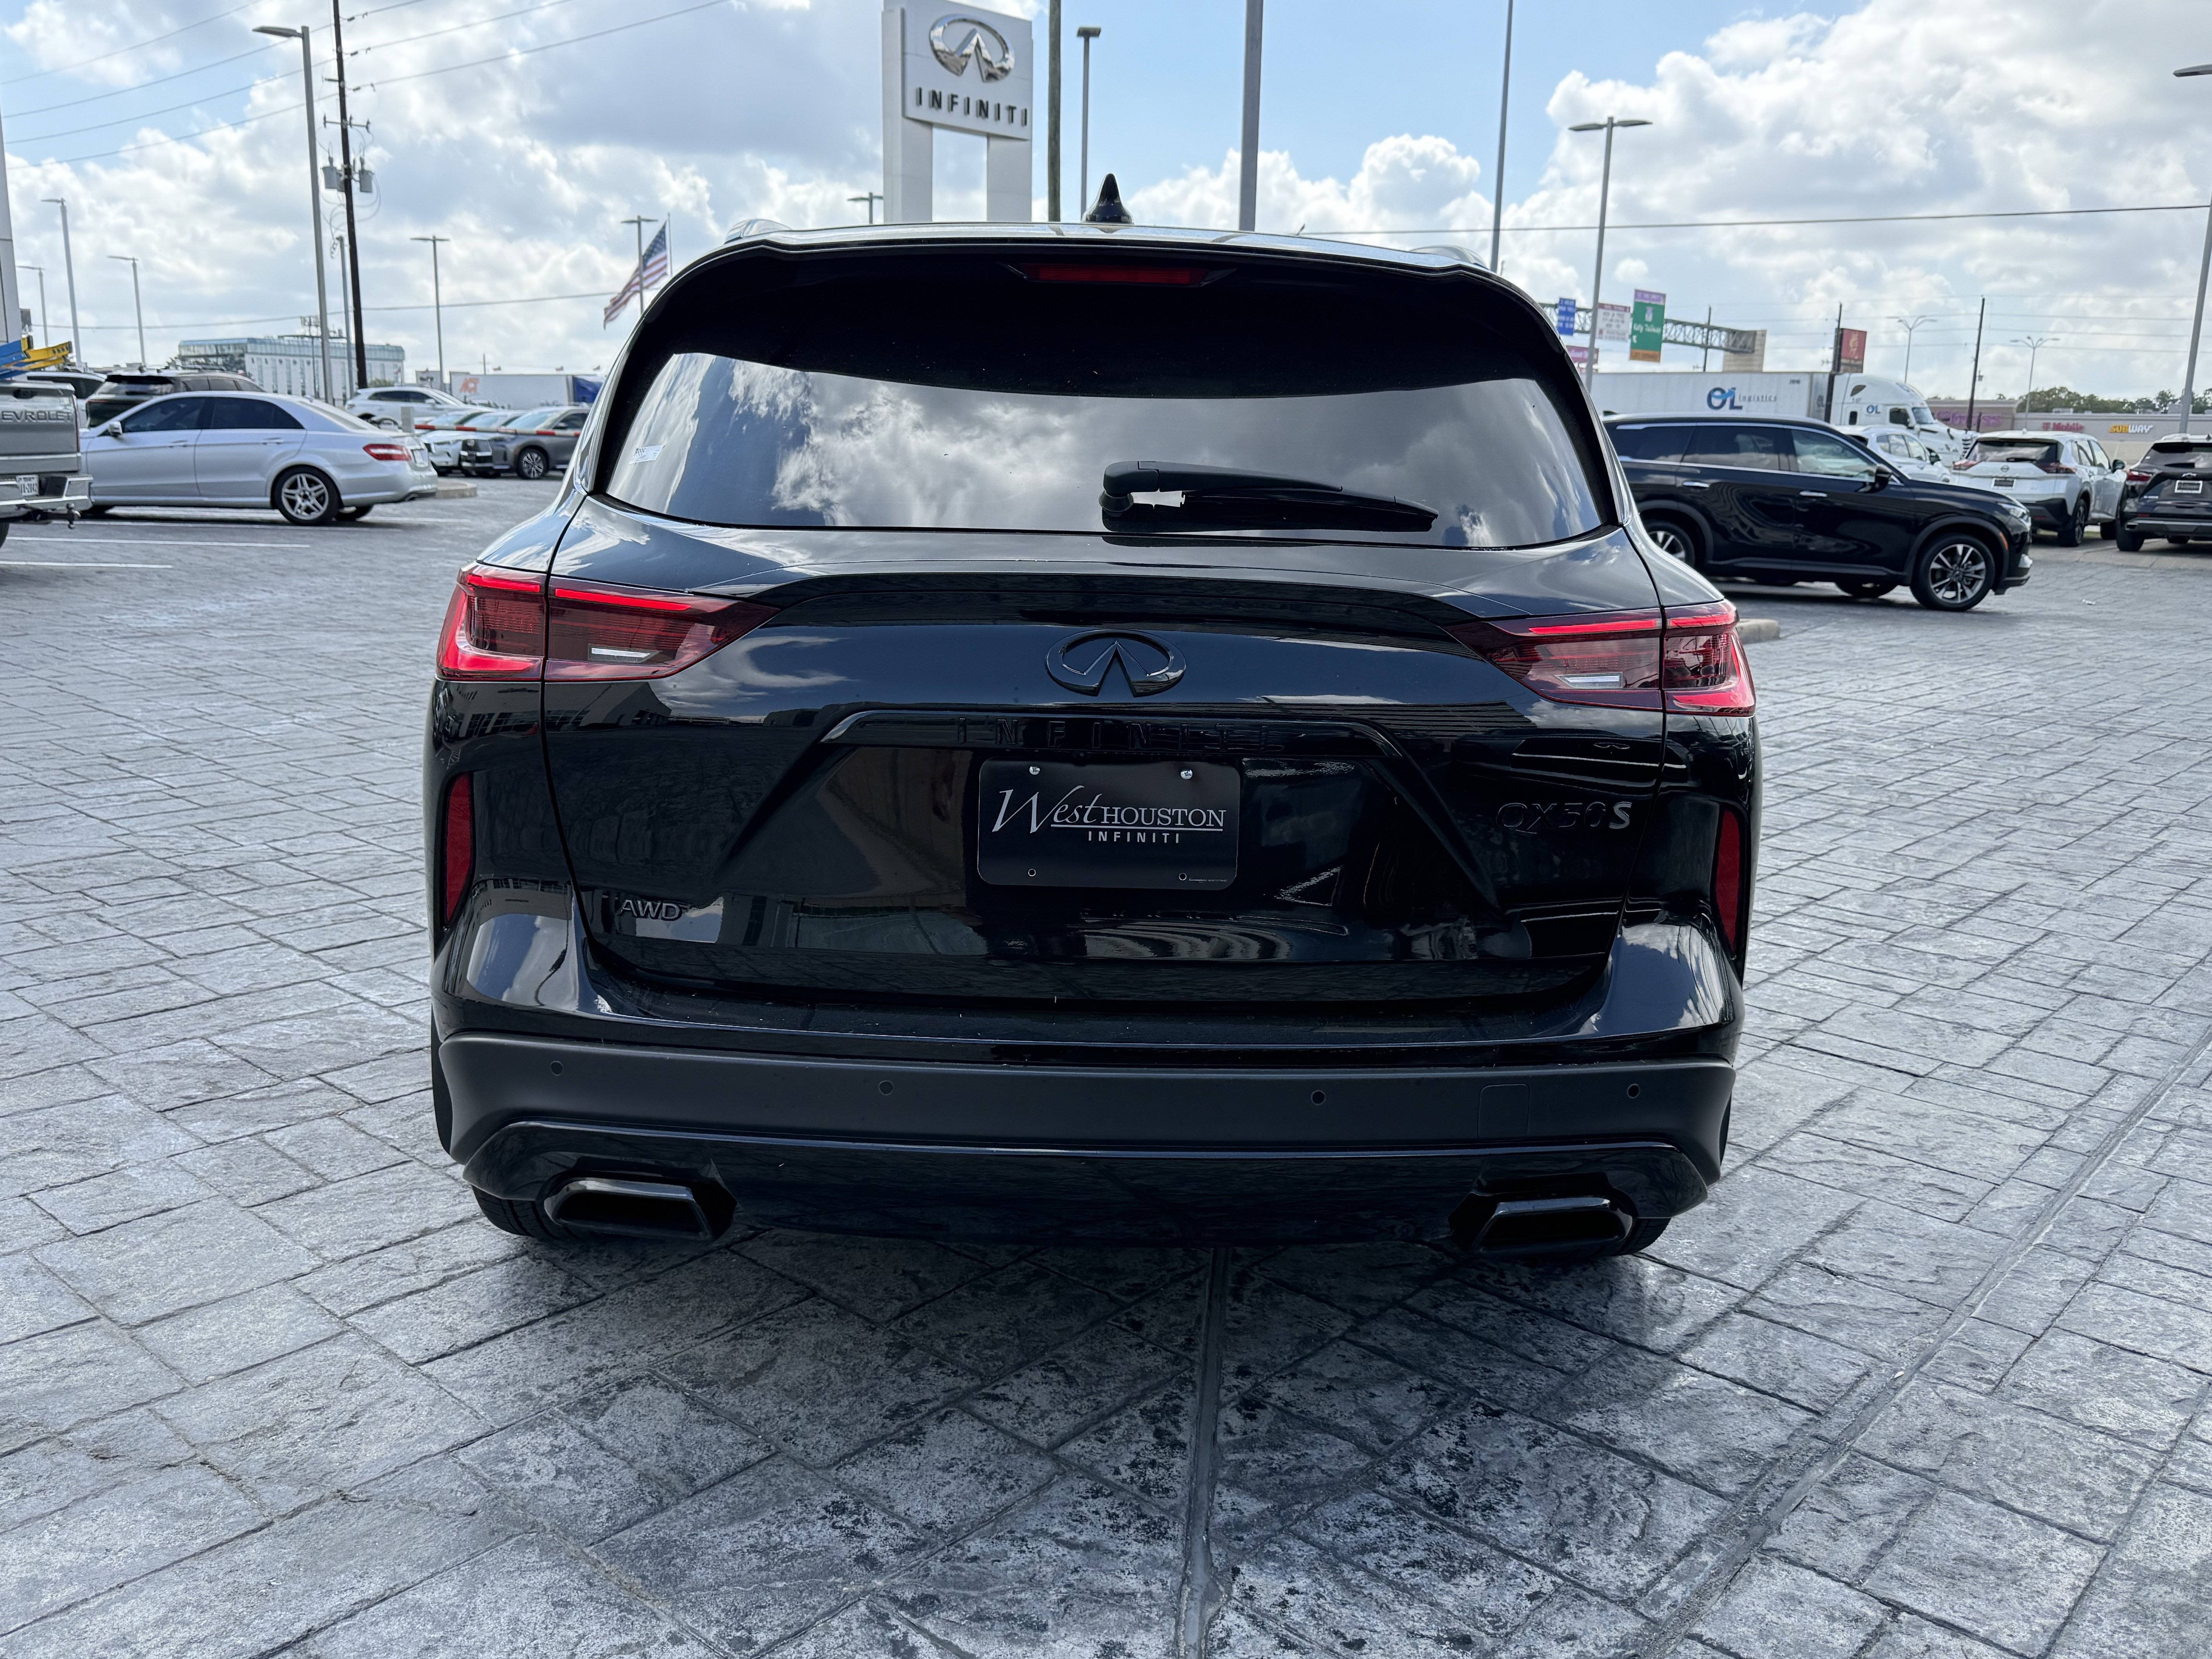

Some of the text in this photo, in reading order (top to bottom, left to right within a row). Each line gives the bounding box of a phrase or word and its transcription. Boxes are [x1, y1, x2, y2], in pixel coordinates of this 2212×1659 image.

[916, 87, 1027, 126] INFINITI
[1738, 394, 1777, 402] logistics
[1, 410, 72, 422] EVROLET
[1867, 405, 1881, 414] OL
[2109, 424, 2153, 433] SUBWAY
[957, 717, 1268, 754] INFINITI
[991, 785, 1226, 834] West HOUSTON
[1088, 831, 1180, 844] INFINITI
[620, 899, 682, 921] AWD
